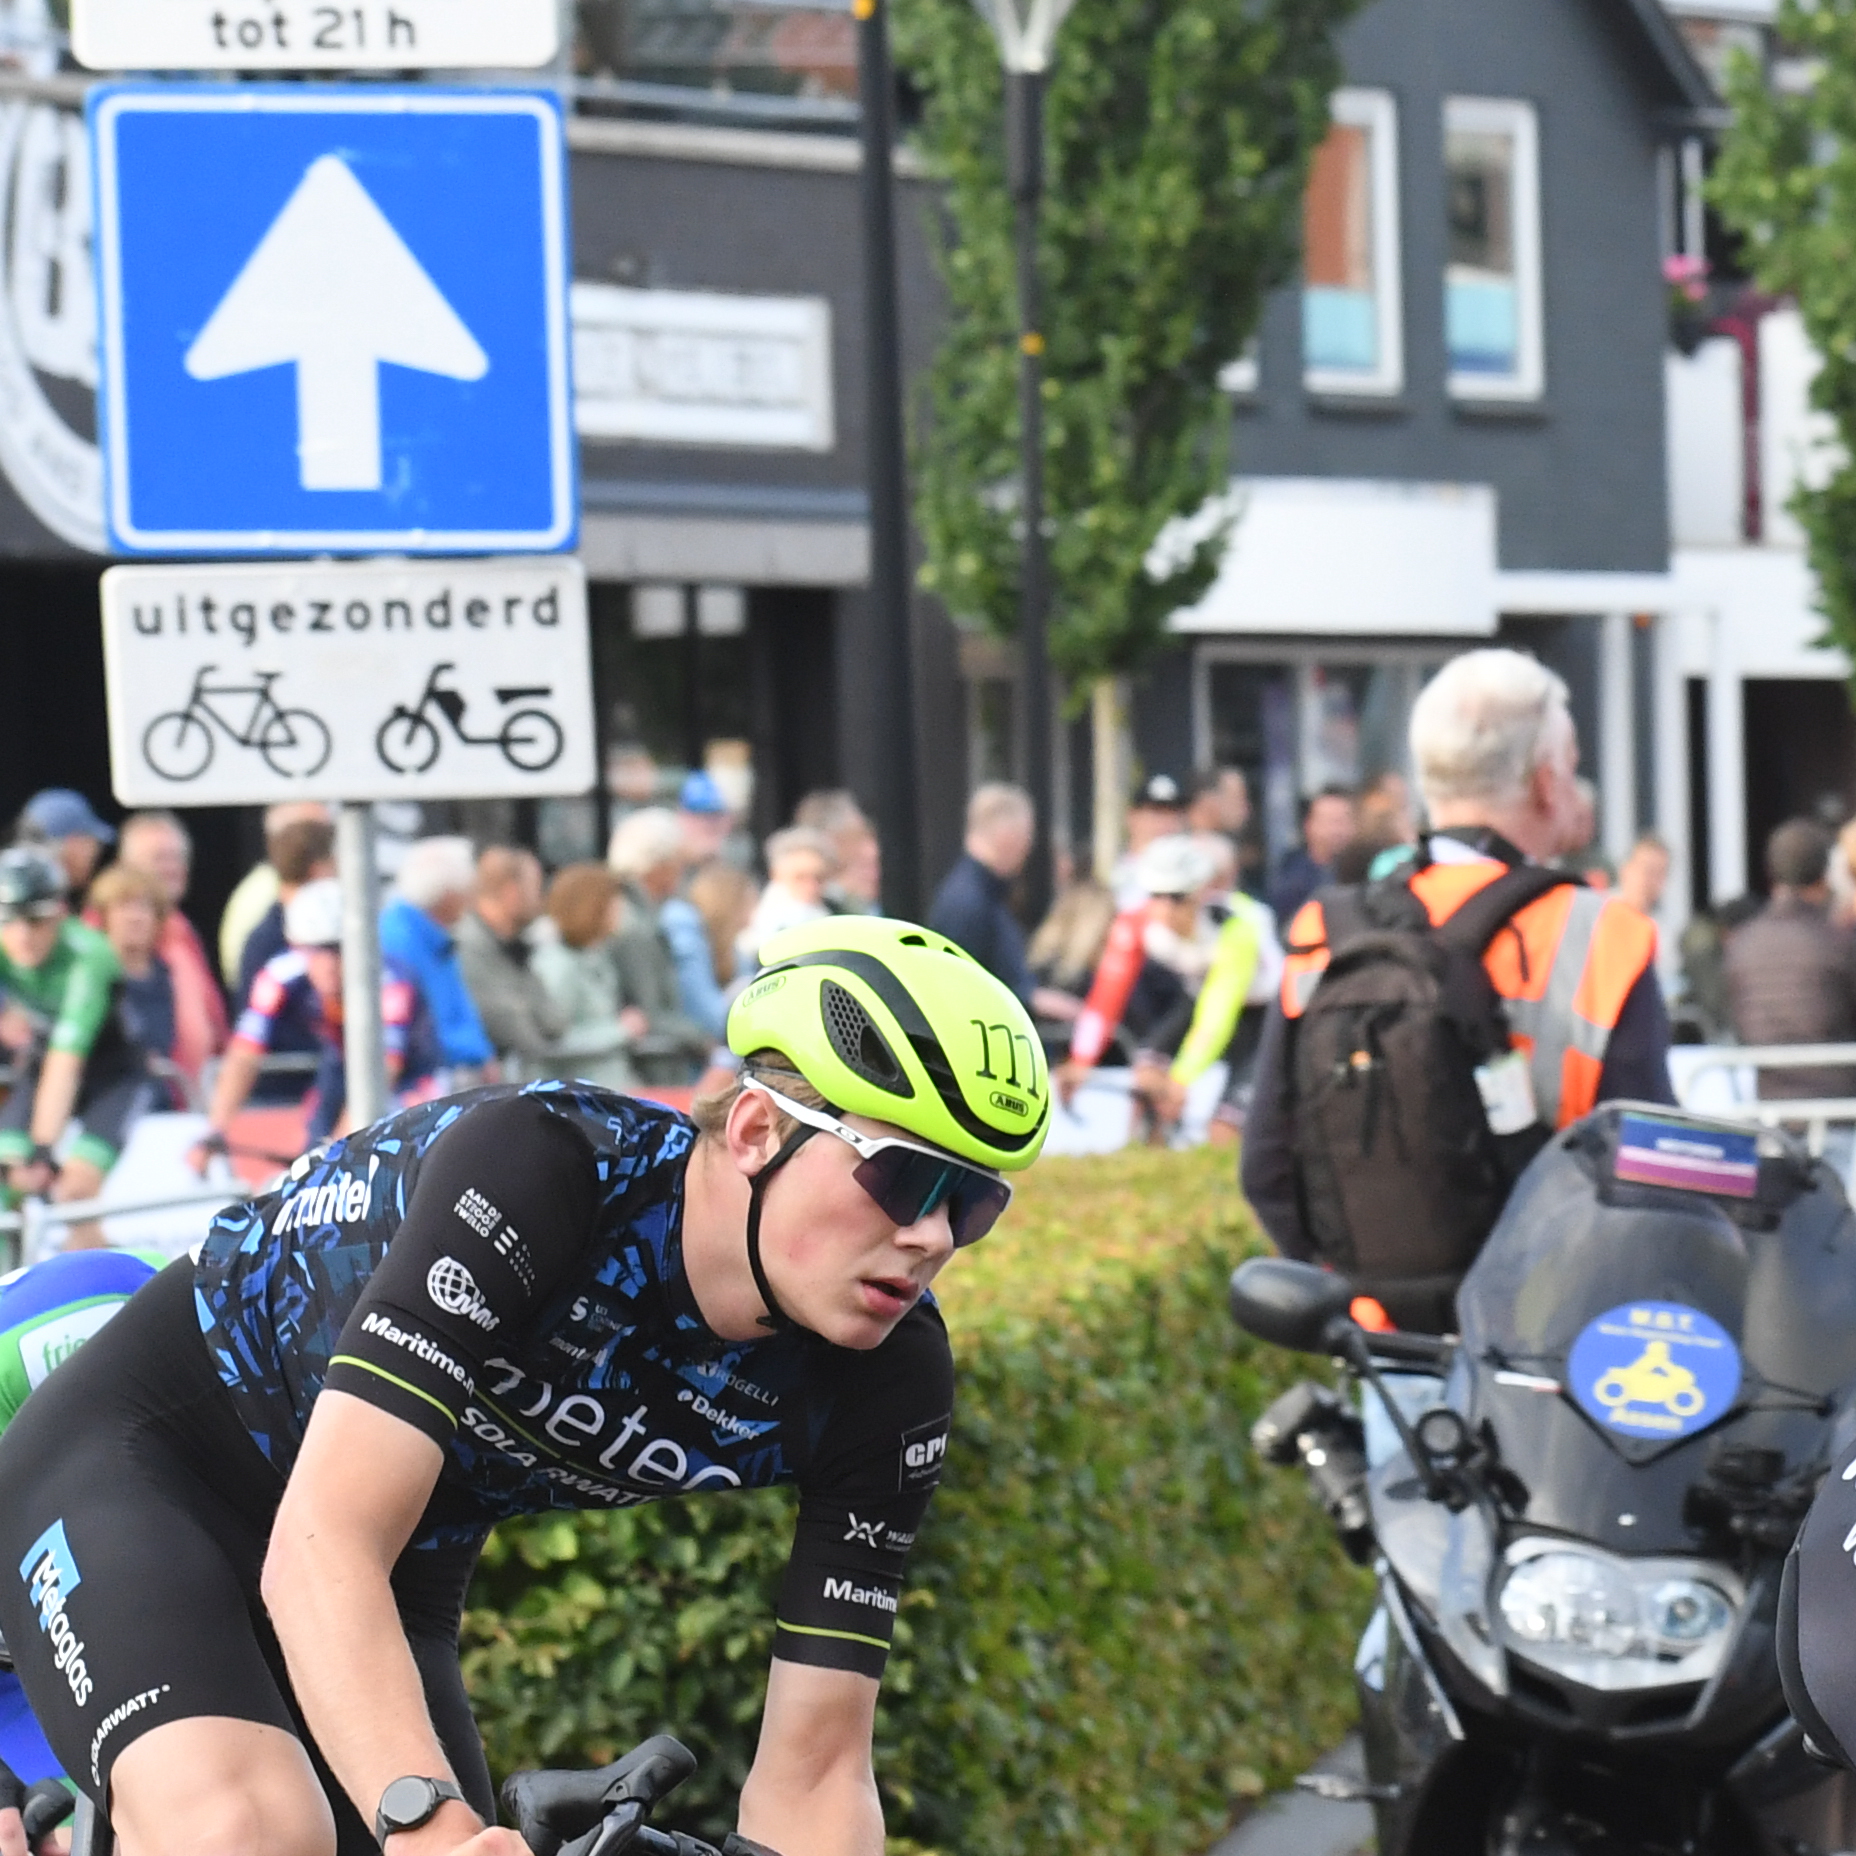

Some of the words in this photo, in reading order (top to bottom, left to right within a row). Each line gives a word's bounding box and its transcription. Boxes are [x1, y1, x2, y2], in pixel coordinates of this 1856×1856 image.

[211, 9, 289, 49] tot
[312, 7, 368, 49] 21
[388, 9, 417, 48] h
[133, 586, 562, 647] uitgezonderd
[690, 1395, 761, 1442] Dekker
[32, 1547, 94, 1707] Metaglas
